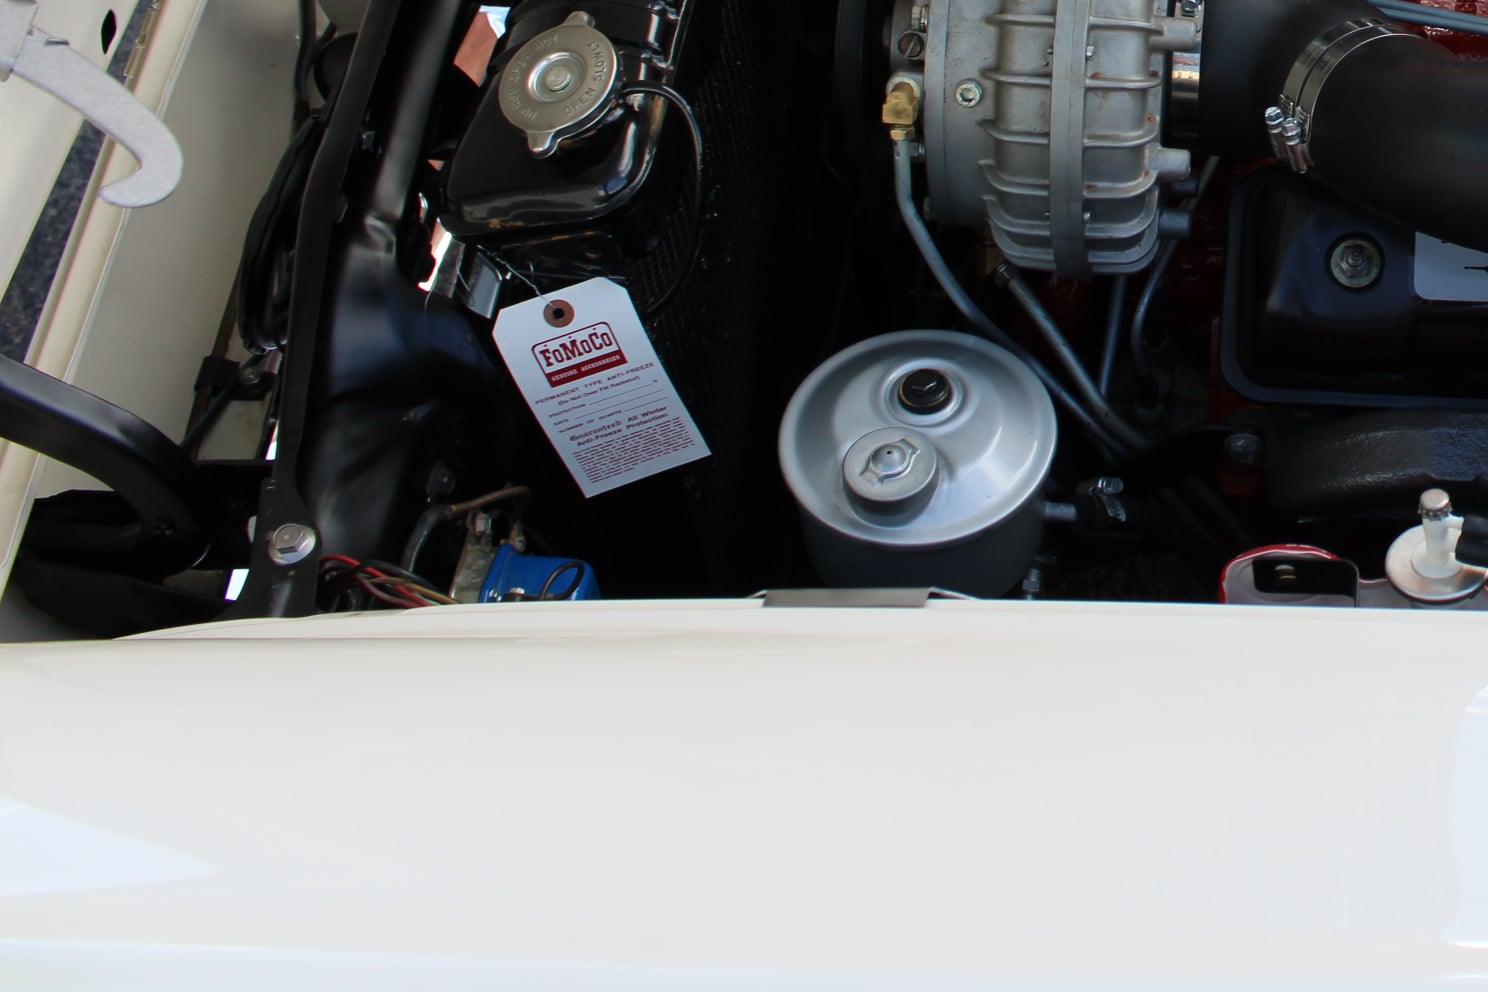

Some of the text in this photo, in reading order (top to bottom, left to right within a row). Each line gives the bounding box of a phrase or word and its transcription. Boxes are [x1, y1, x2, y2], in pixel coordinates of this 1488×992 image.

[564, 41, 607, 115] OPEN SLOWLY
[539, 330, 613, 368] FoMoCo
[535, 362, 655, 405] PERMANENT TYPE ANTI-FREEZE
[577, 413, 669, 447] Anti-Freeze Protection
[640, 406, 667, 418] Winter
